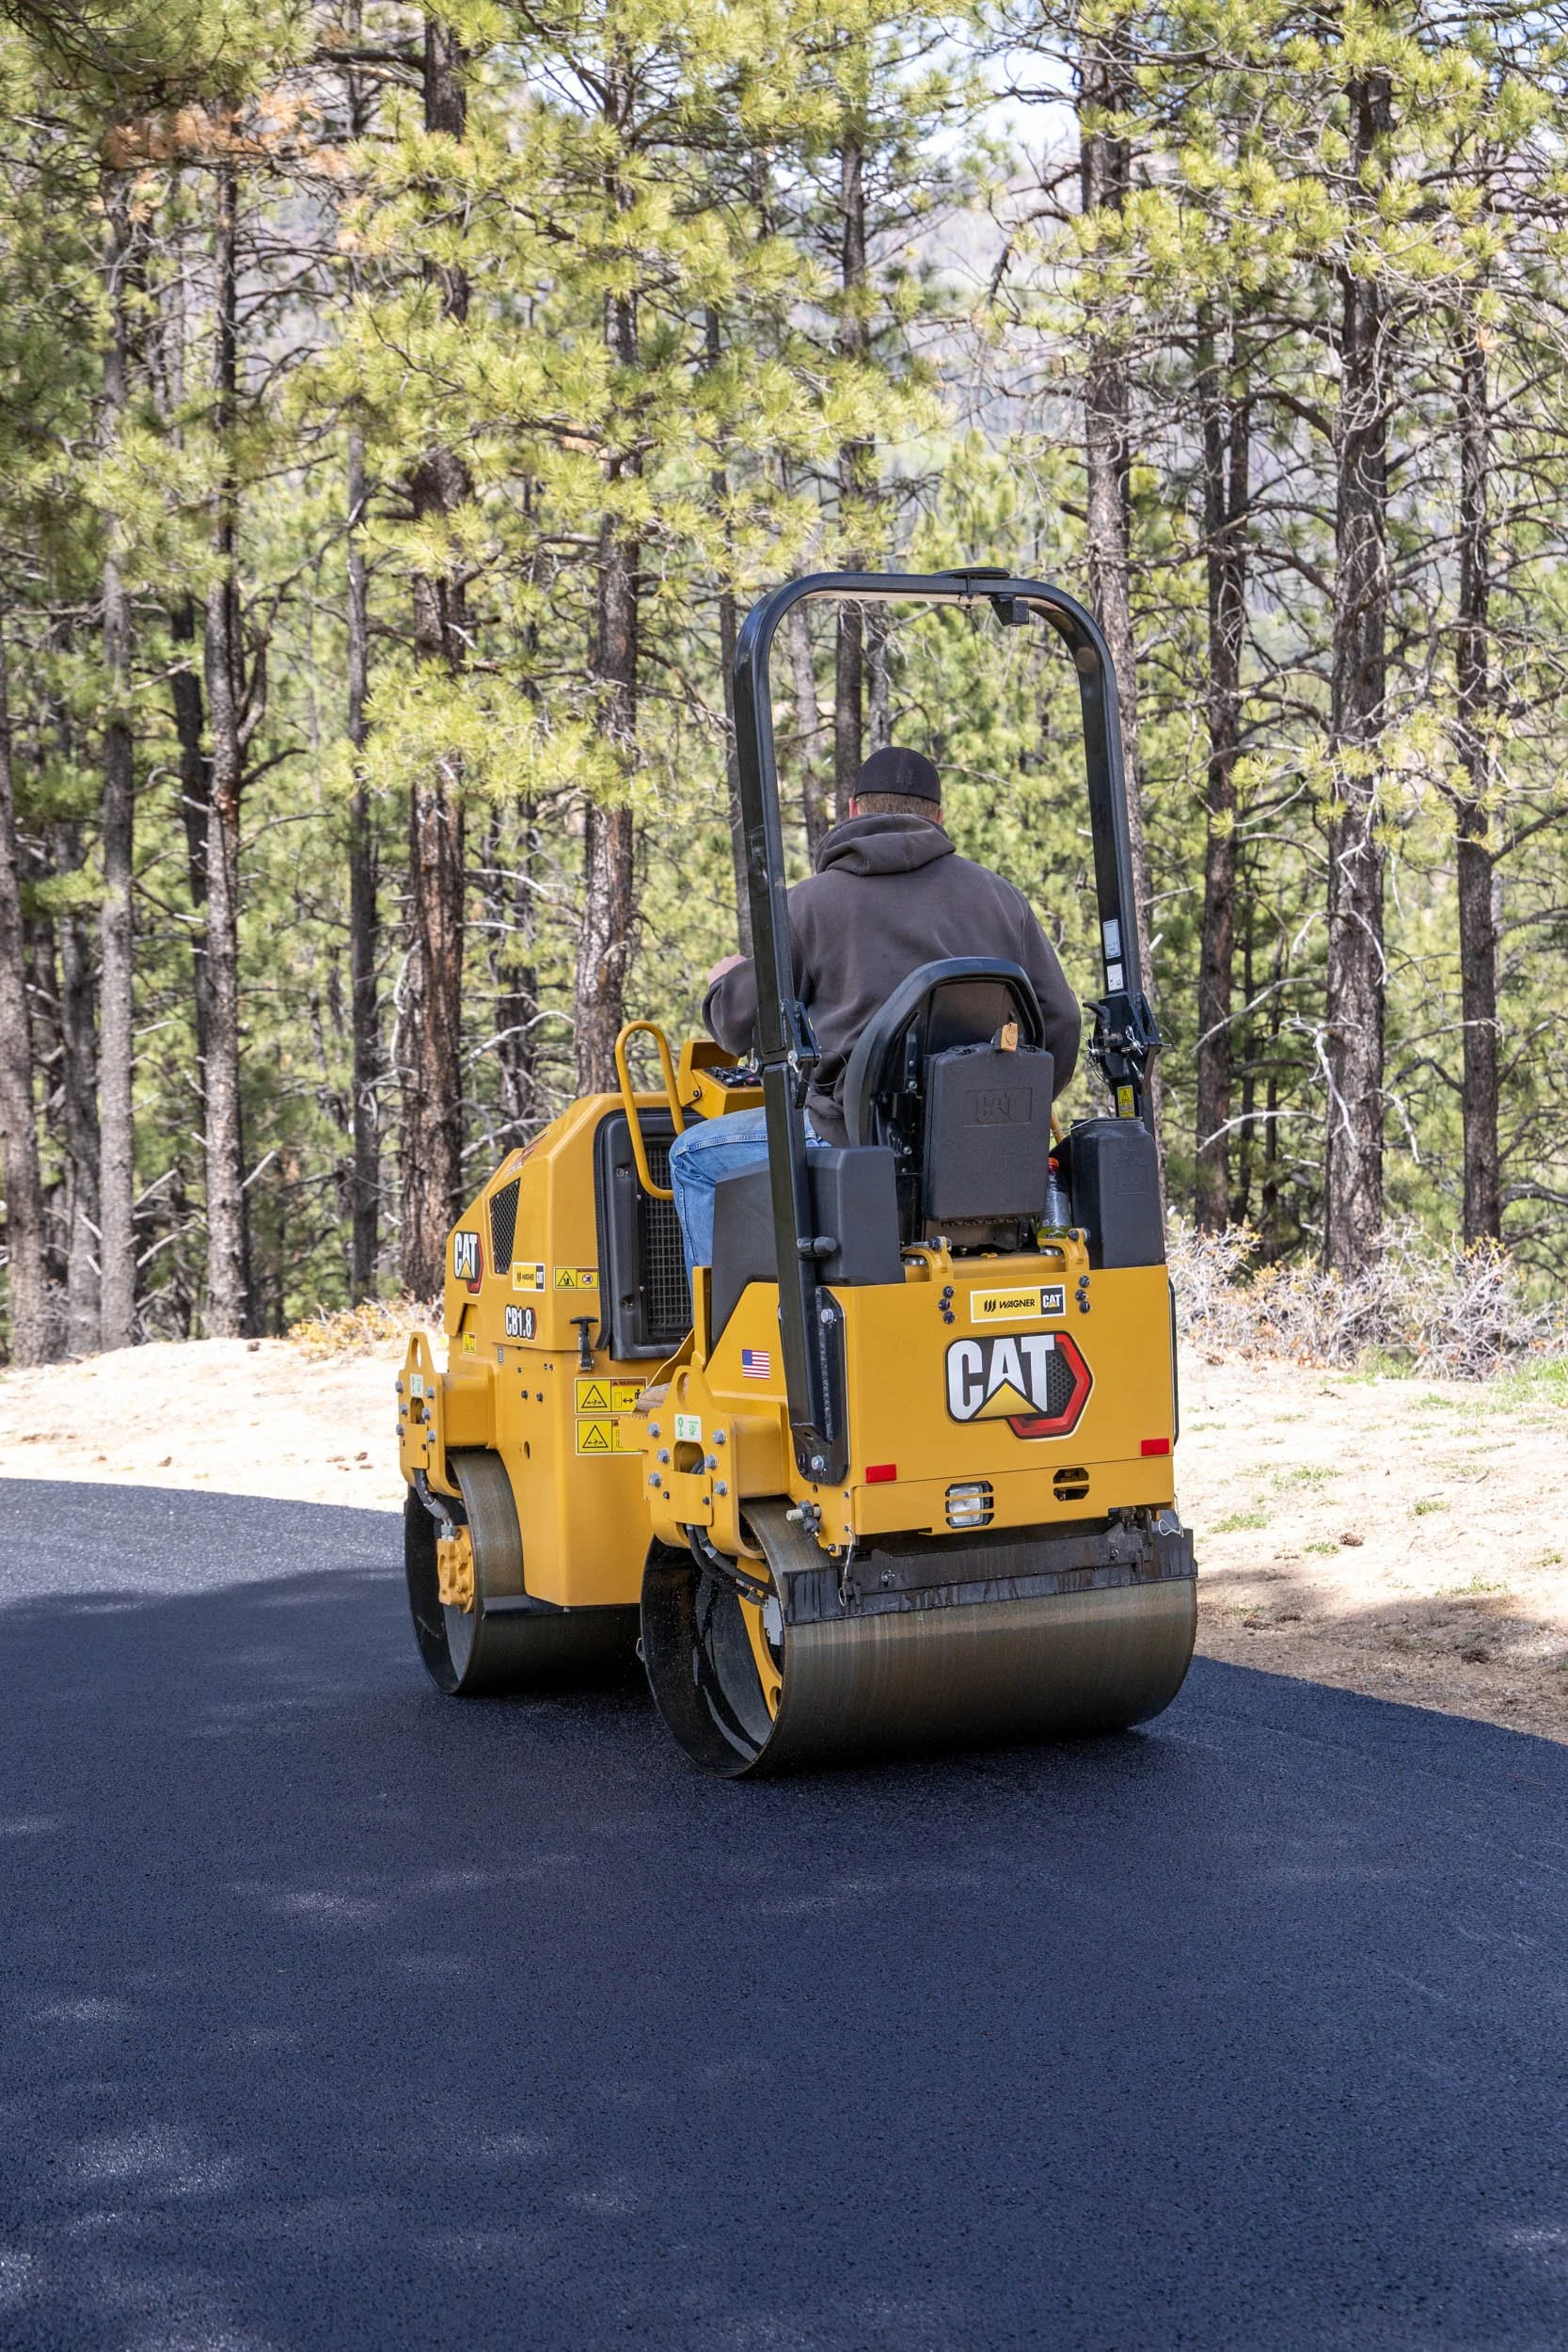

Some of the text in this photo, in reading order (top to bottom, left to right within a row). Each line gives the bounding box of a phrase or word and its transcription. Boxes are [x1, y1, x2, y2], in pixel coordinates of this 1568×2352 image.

[454, 1232, 478, 1279] CAT
[999, 1294, 1061, 1309] WAGNER CAT
[505, 1306, 531, 1338] CB1.8
[947, 1334, 1055, 1420] CAT
